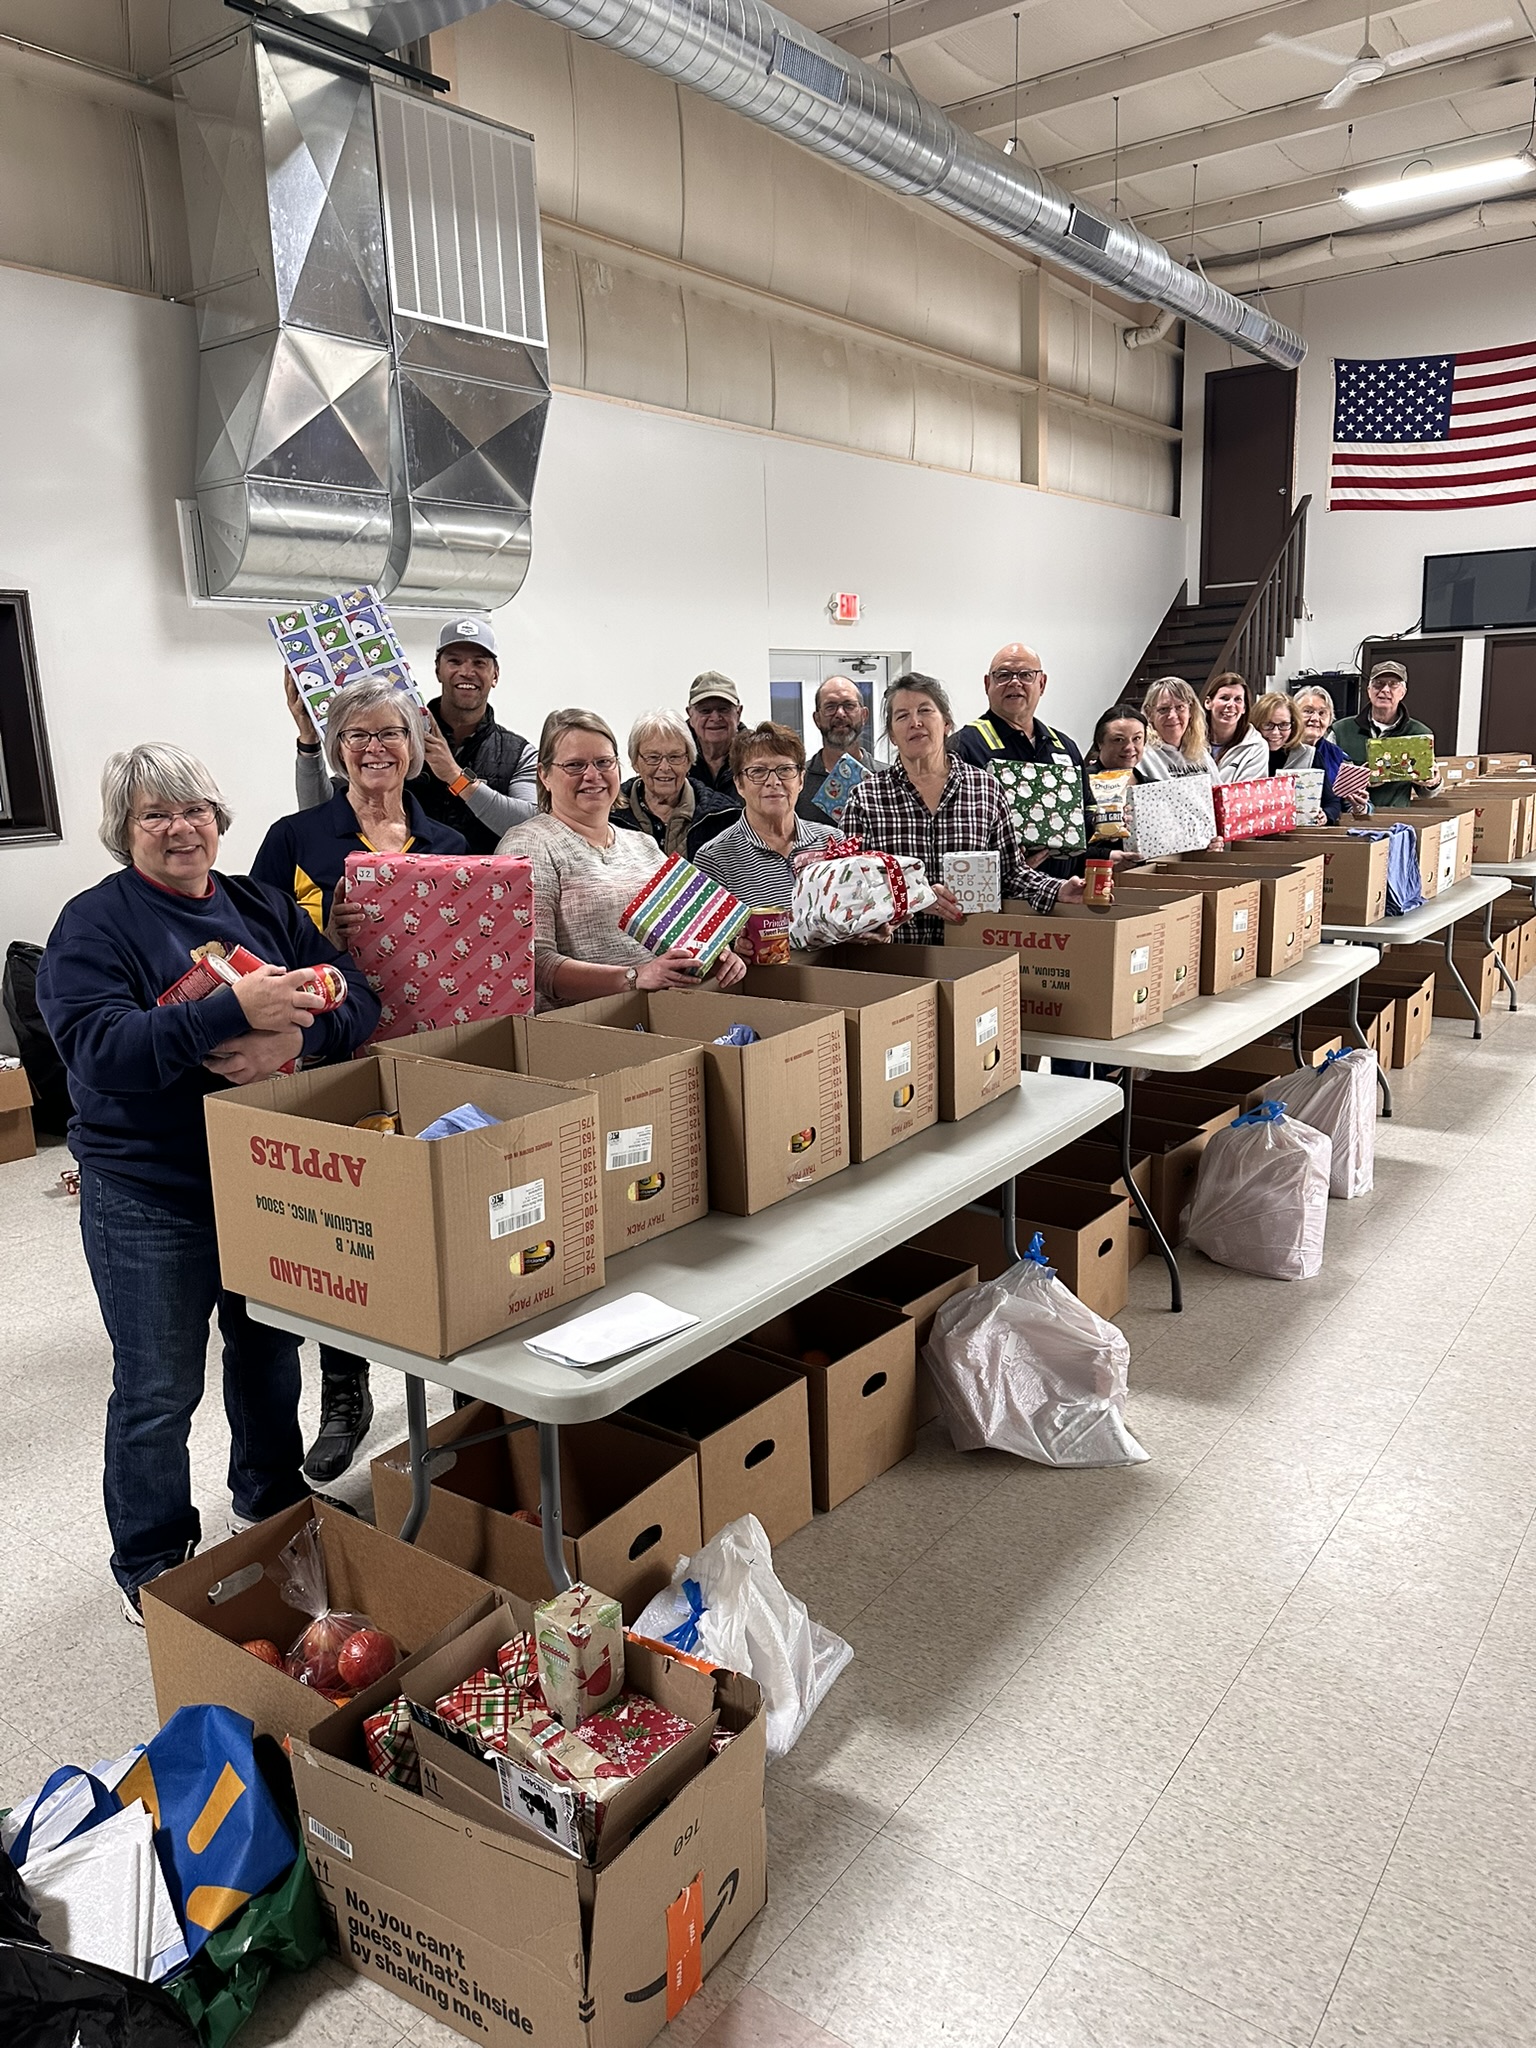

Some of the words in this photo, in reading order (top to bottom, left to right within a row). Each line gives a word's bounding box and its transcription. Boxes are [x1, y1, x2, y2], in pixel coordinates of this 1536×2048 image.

[982, 928, 1071, 951] APPLES
[1030, 965, 1071, 978] BELGIUM,
[1041, 979, 1047, 989] B
[1052, 980, 1071, 991] HWY.
[1020, 1001, 1063, 1017] APPLE
[831, 1029, 840, 1041] 175
[688, 1066, 698, 1078] 175
[688, 1079, 699, 1091] 163
[689, 1092, 699, 1104] 150
[689, 1104, 700, 1117] 138
[582, 1116, 595, 1130] 175
[690, 1118, 700, 1129] 125
[582, 1131, 595, 1144] 163
[690, 1130, 701, 1142] 113
[583, 1145, 596, 1160] 150
[691, 1143, 701, 1155] 100
[250, 1135, 367, 1188] APPLES
[583, 1160, 597, 1174] 138
[691, 1157, 698, 1168] 88
[584, 1175, 597, 1189] 125
[691, 1170, 698, 1180] 80
[691, 1182, 698, 1192] 72
[584, 1189, 597, 1204] 113
[691, 1194, 699, 1205] 64
[255, 1194, 285, 1215] 53004
[585, 1204, 598, 1218] 100
[287, 1203, 318, 1225] WISC.
[648, 1212, 665, 1228] TRAY
[320, 1208, 373, 1238] BELGIUM,
[585, 1220, 595, 1232] 88
[627, 1220, 646, 1236] PACK
[335, 1237, 343, 1252] B
[585, 1234, 595, 1246] 80
[346, 1239, 375, 1260] HWY.
[586, 1249, 595, 1261] 72
[586, 1262, 595, 1276] 64
[269, 1255, 369, 1307] APPLELAND
[534, 1285, 555, 1304] TRAY
[509, 1295, 532, 1315] PACK
[520, 1773, 550, 1798] UN3481
[369, 1781, 378, 1793] C
[465, 1827, 473, 1839] C
[345, 1887, 375, 1923] No,
[377, 1907, 413, 1941] you
[416, 1931, 466, 1971] can't
[348, 1915, 402, 1957] guess
[405, 1946, 470, 1996] what's
[472, 1980, 535, 2035] inside
[350, 1934, 371, 1965] by
[375, 1952, 449, 2011] shaking
[453, 1997, 490, 2032] me.
